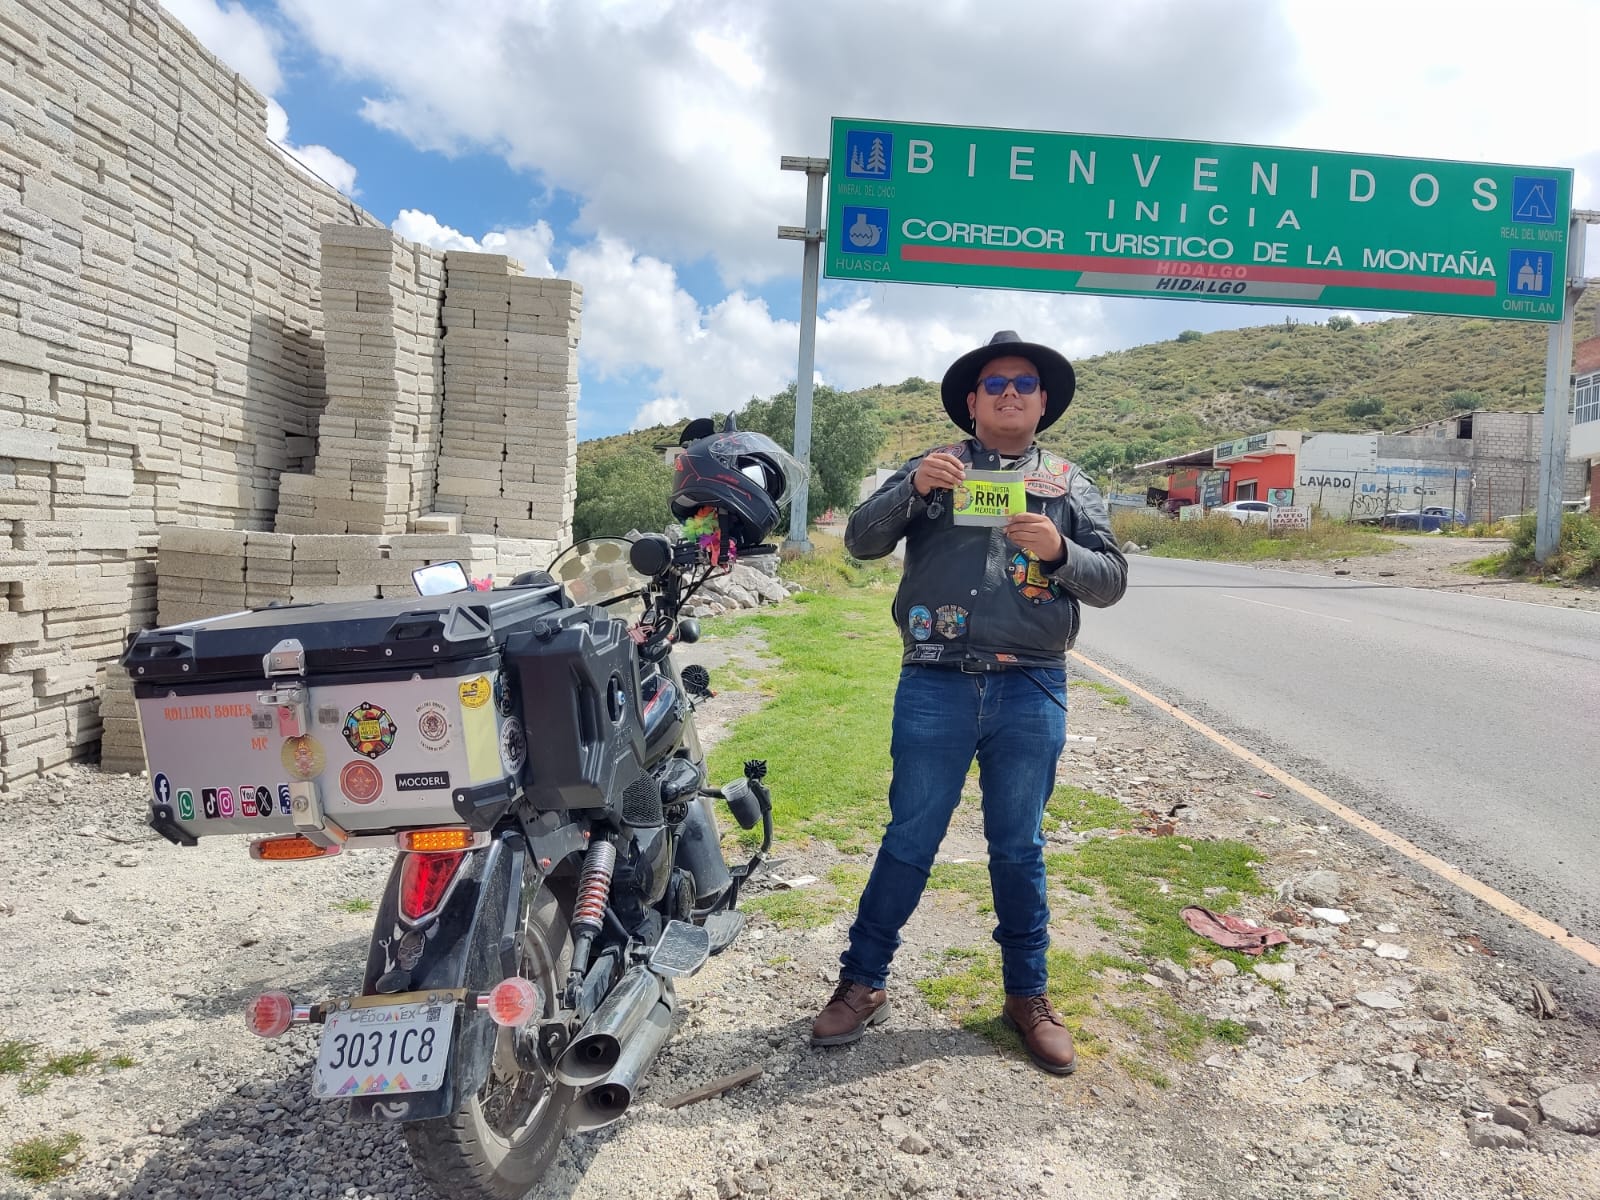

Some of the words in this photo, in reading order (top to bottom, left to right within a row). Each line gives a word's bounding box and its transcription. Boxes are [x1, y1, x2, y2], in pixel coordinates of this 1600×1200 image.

[907, 139, 1498, 212] BIENVENIDOS
[864, 185, 874, 197] DEL
[1108, 199, 1301, 230] INICIA
[1500, 226, 1519, 240] REAL
[1522, 228, 1535, 241] DEL
[1538, 229, 1564, 243] MONTE
[901, 218, 1065, 249] CORREDOR
[1085, 231, 1234, 260] TURISTICO
[1253, 241, 1289, 263] DE
[1306, 244, 1343, 267] LA
[1362, 248, 1497, 277] MONTAÑA
[835, 258, 891, 273] HUASCA
[1156, 261, 1248, 278] HIDALGO
[1155, 277, 1247, 295] HIDALGO
[1502, 299, 1556, 315] OMITLAN
[1300, 474, 1351, 489] LAVADO
[975, 490, 1009, 508] RRM
[164, 704, 212, 721] ROLLING
[214, 703, 253, 719] BONES
[251, 736, 269, 751] MC
[398, 777, 447, 787] MOCOERL
[241, 789, 255, 800] You
[242, 803, 257, 814] Tube
[329, 1026, 436, 1070] 3031C8
